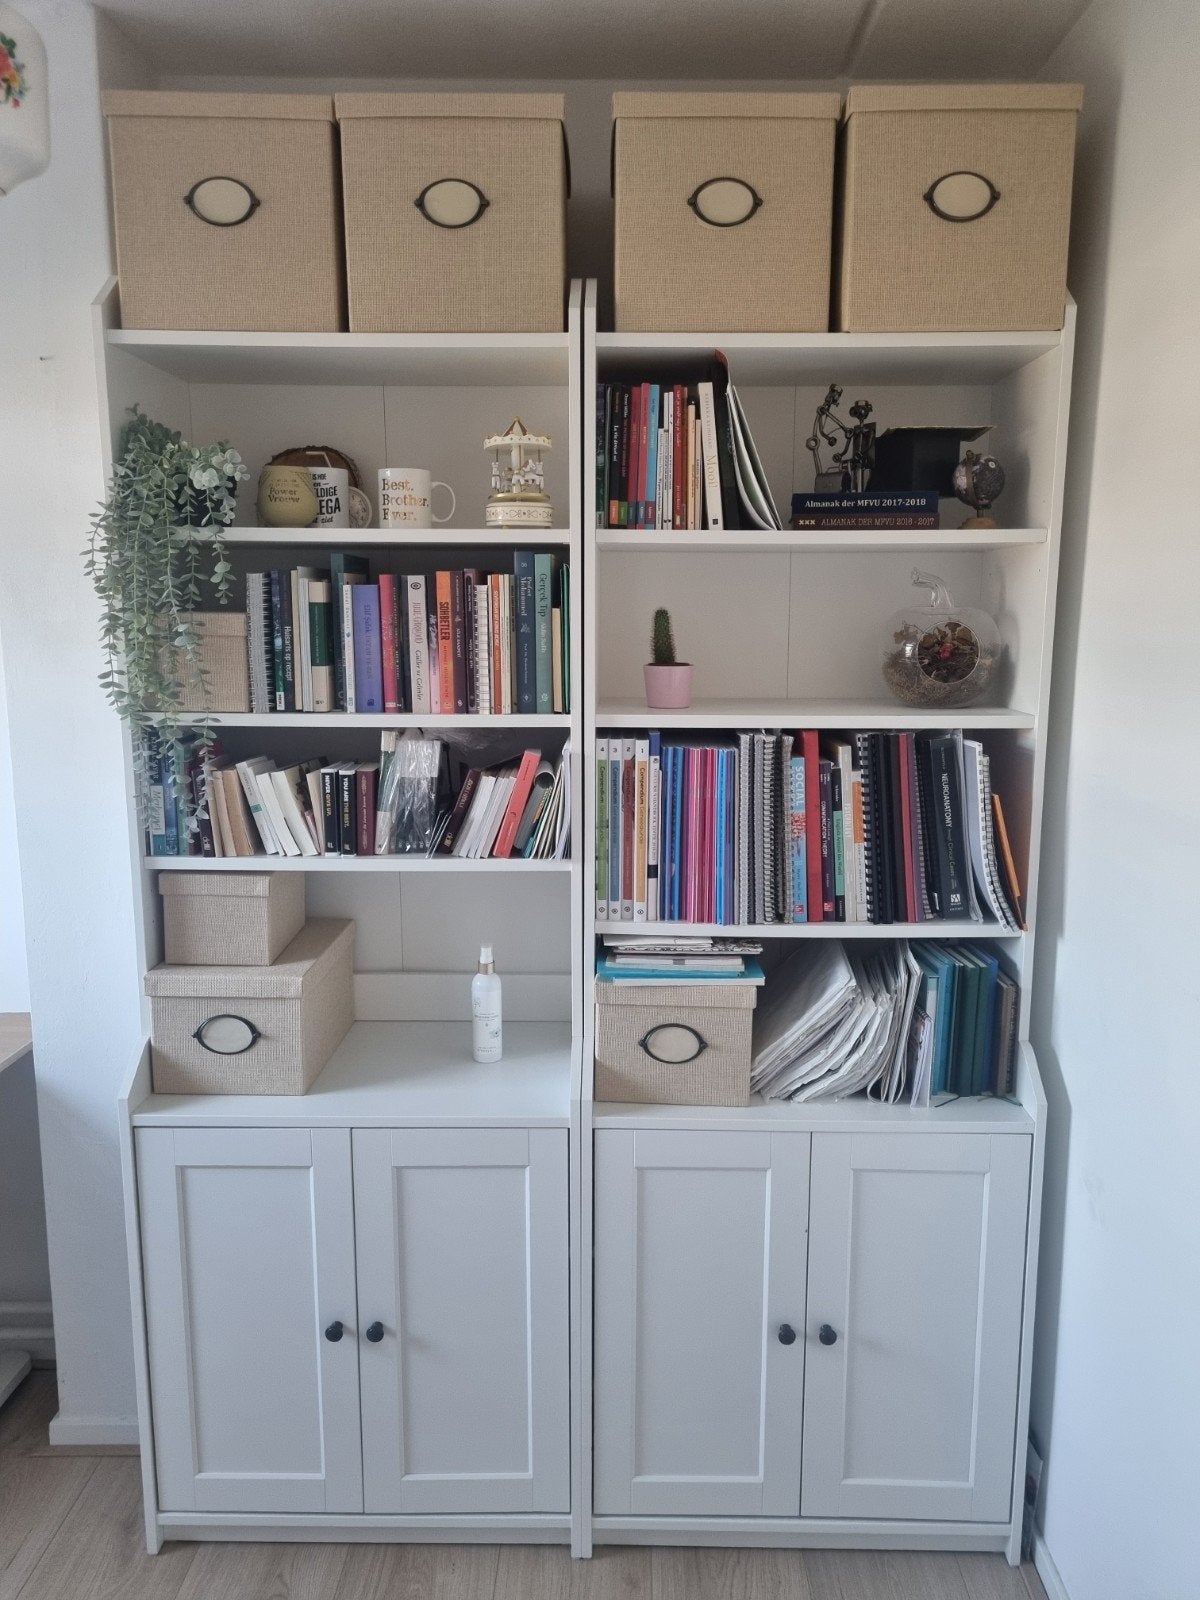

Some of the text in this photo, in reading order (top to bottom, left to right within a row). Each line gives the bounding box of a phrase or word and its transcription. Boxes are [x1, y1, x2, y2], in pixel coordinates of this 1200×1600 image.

[706, 454, 718, 488] Mooi!
[270, 487, 298, 496] Power
[382, 479, 414, 491] Best.
[382, 494, 429, 507] Brother.
[805, 500, 840, 508] Almanak
[383, 508, 416, 520] Ever.
[821, 518, 856, 526] ALMANAK
[537, 573, 547, 602] Gerçek
[537, 604, 548, 617] Tıp
[440, 602, 450, 640] SOHBETLER
[284, 626, 293, 681] Huisarts op recept
[795, 766, 804, 806] SOCIAL
[942, 773, 952, 827] NEUROANATOMY
